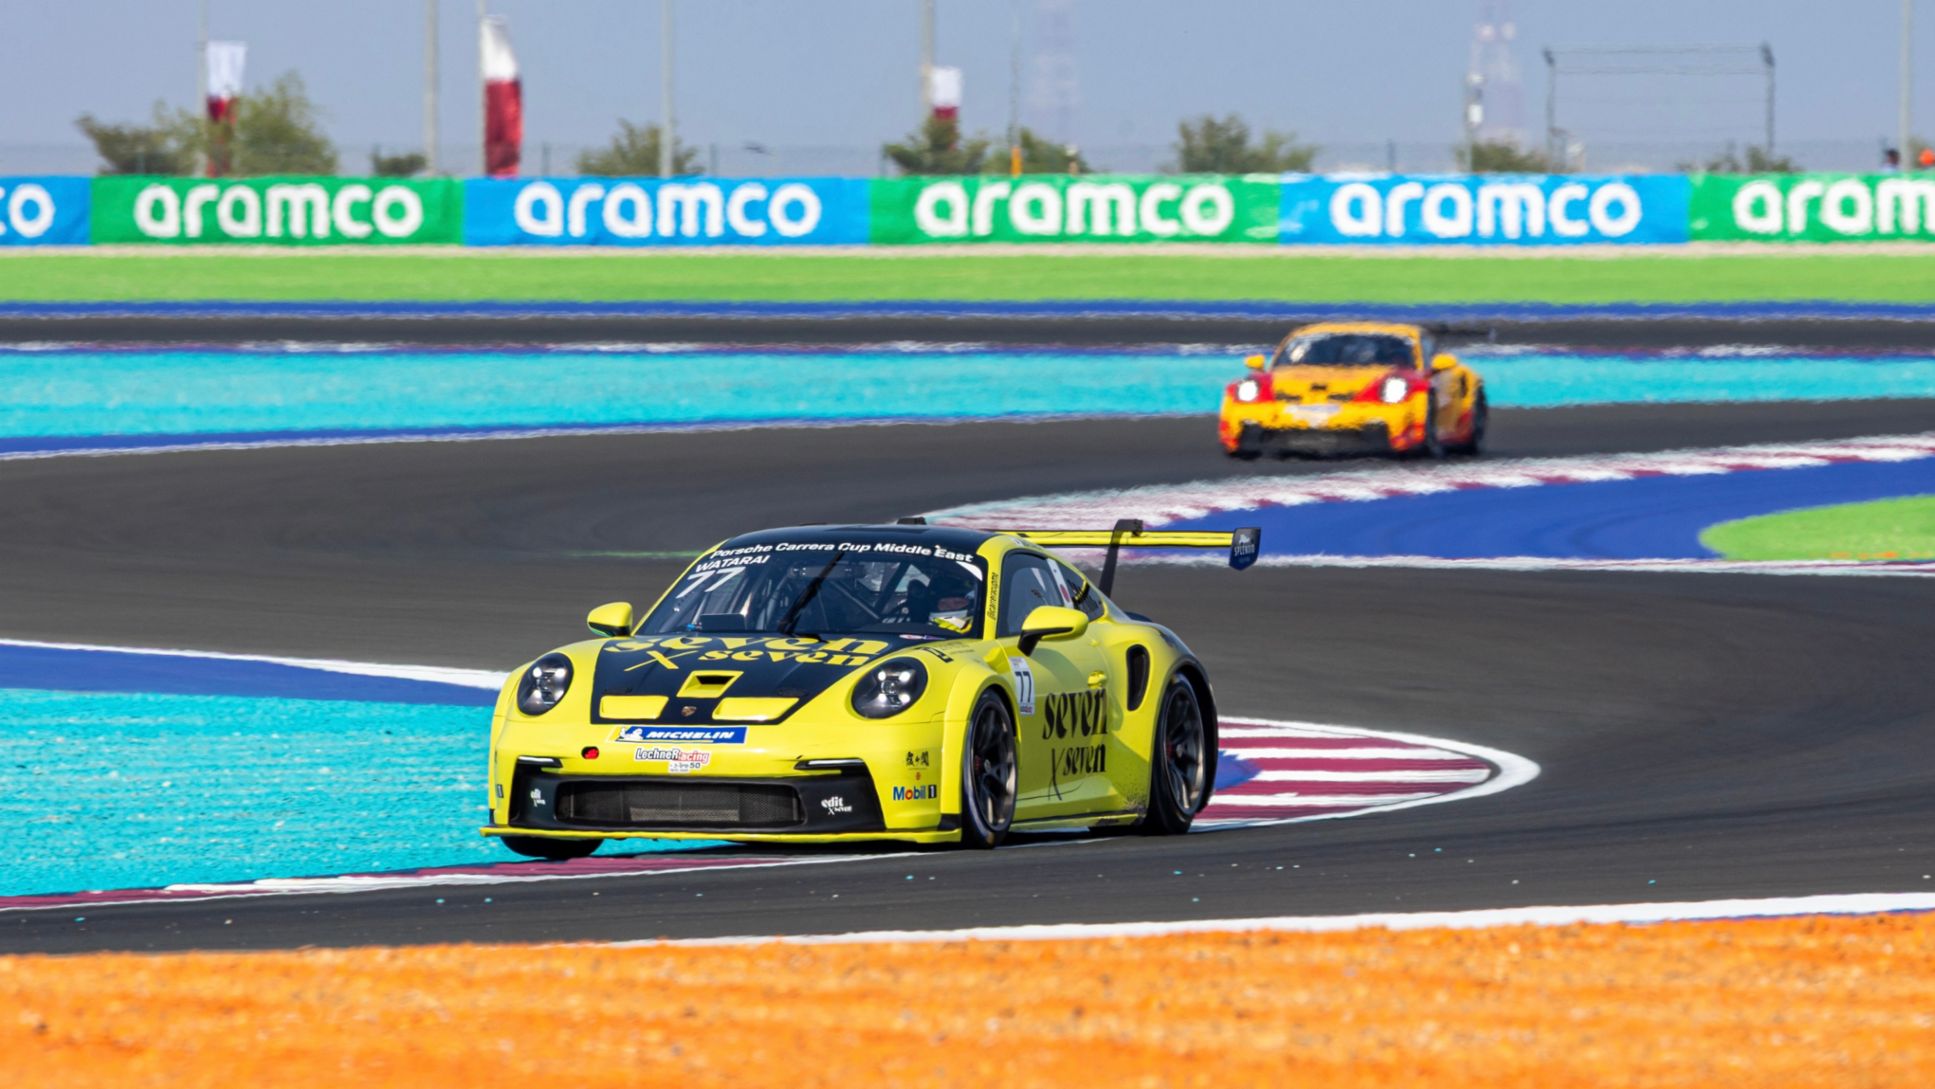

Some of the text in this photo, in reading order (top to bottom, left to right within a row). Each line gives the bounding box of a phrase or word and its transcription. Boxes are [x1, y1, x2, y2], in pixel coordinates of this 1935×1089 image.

[134, 183, 423, 238] aramco
[514, 181, 822, 238] aramco
[914, 181, 1234, 237] aramco
[1329, 182, 1642, 239] aramco
[695, 555, 771, 573] WATARAI
[710, 542, 974, 563] Porsche Carrera Cup Middle East
[675, 566, 747, 599] 77
[603, 637, 889, 654] seven
[698, 651, 871, 667] seven
[1015, 671, 1032, 703] 77
[1042, 687, 1108, 740] seven
[646, 731, 735, 740] MICHELIN
[1062, 743, 1107, 776] seven
[893, 786, 926, 801] Mobil
